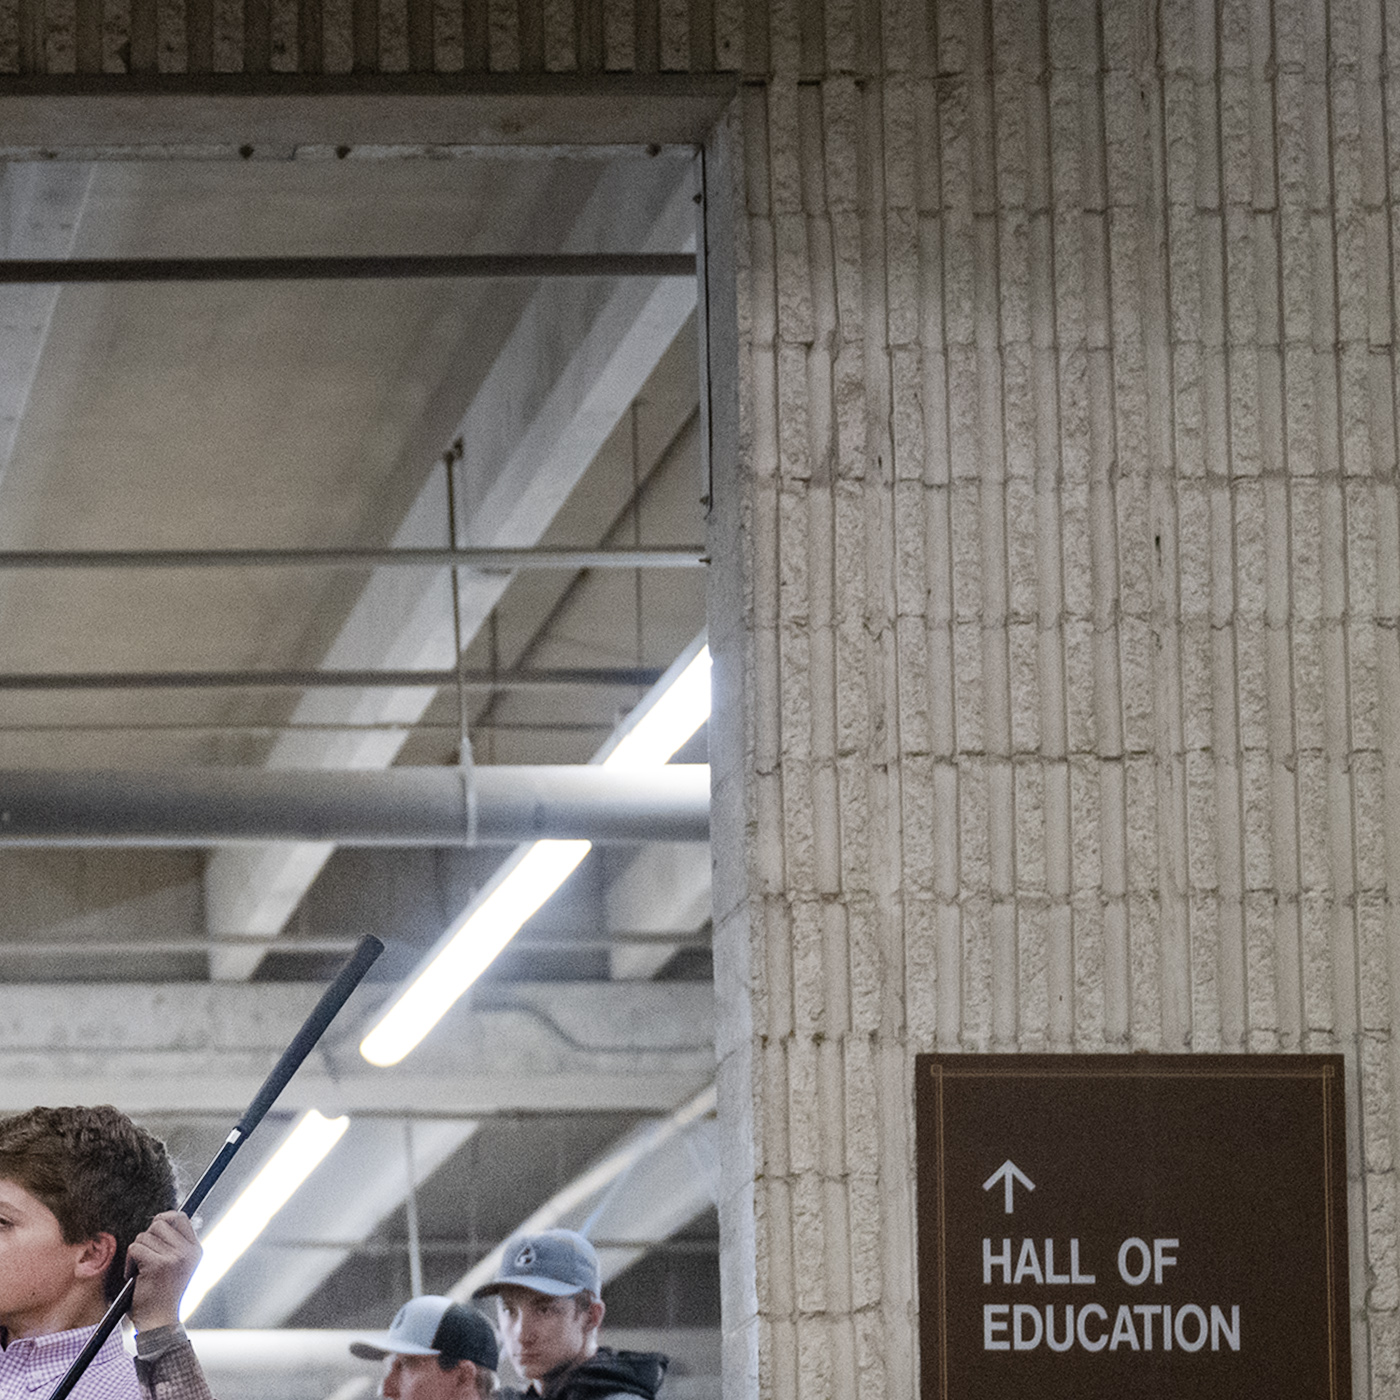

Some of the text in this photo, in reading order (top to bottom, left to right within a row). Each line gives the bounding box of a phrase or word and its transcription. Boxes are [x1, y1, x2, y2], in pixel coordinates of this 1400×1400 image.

[982, 1237, 1180, 1286] HALL OF
[983, 1303, 1241, 1353] EDUCATION
